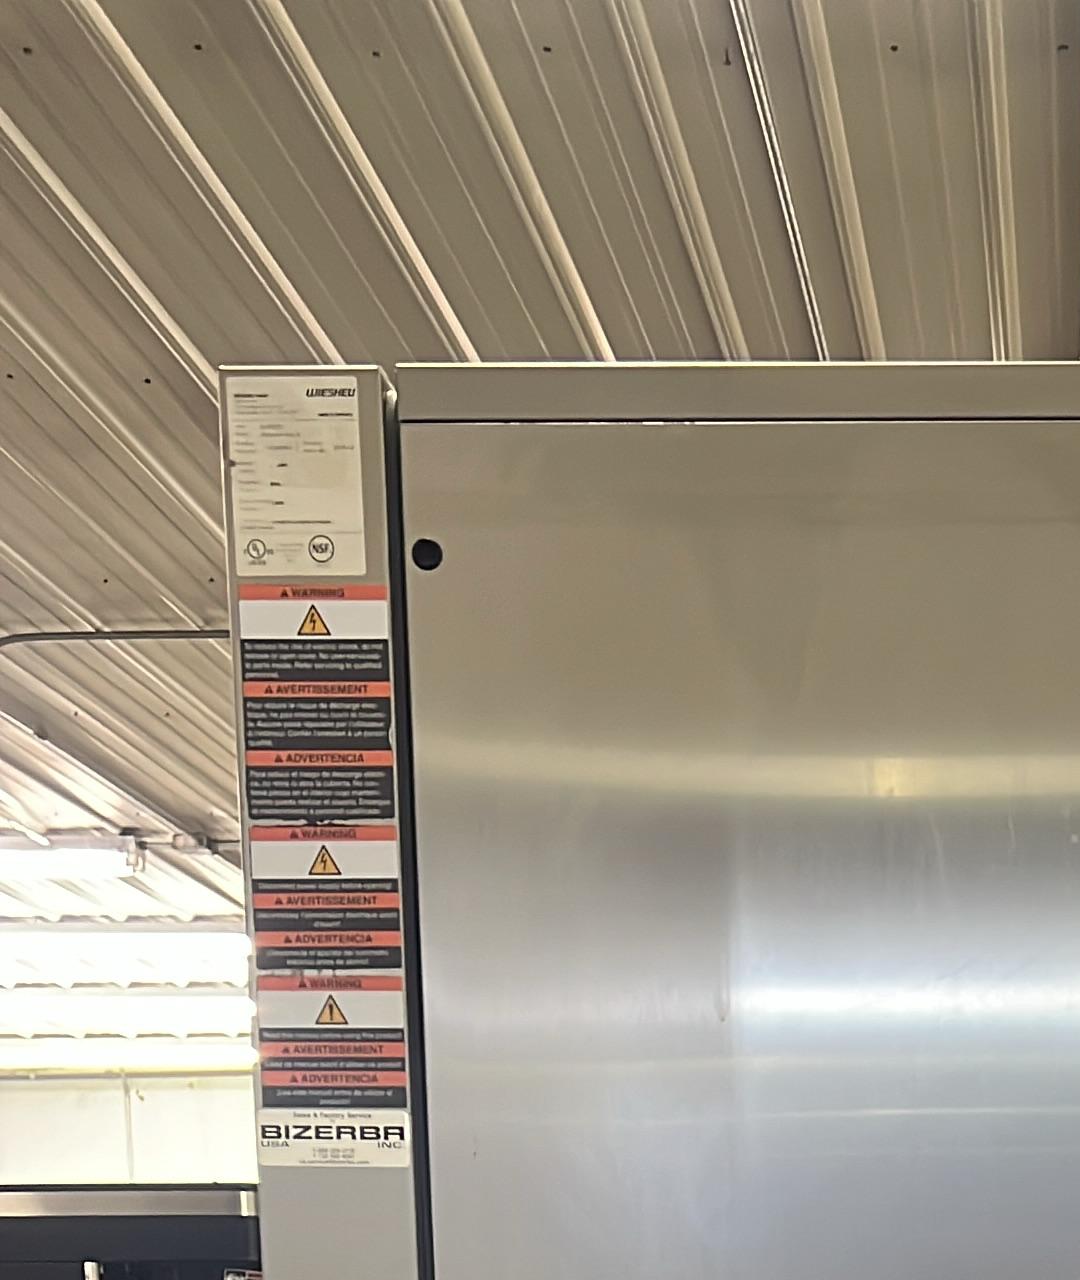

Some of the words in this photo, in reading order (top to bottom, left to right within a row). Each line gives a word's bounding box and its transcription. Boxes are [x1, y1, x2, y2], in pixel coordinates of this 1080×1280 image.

[276, 684, 368, 694] AVERTISSEMENT
[286, 753, 364, 763] ADVERTENCIA
[301, 829, 357, 839] WARNING
[286, 896, 377, 906] AVERTISSEMENT
[295, 934, 373, 944] ADVERTENCIA
[310, 979, 362, 988] WARNING
[293, 1045, 384, 1055] AVERTISSEMENT
[301, 1074, 379, 1084] ADVERTENCIA
[261, 1125, 405, 1141] BIZERBA
[261, 1140, 290, 1148] USA
